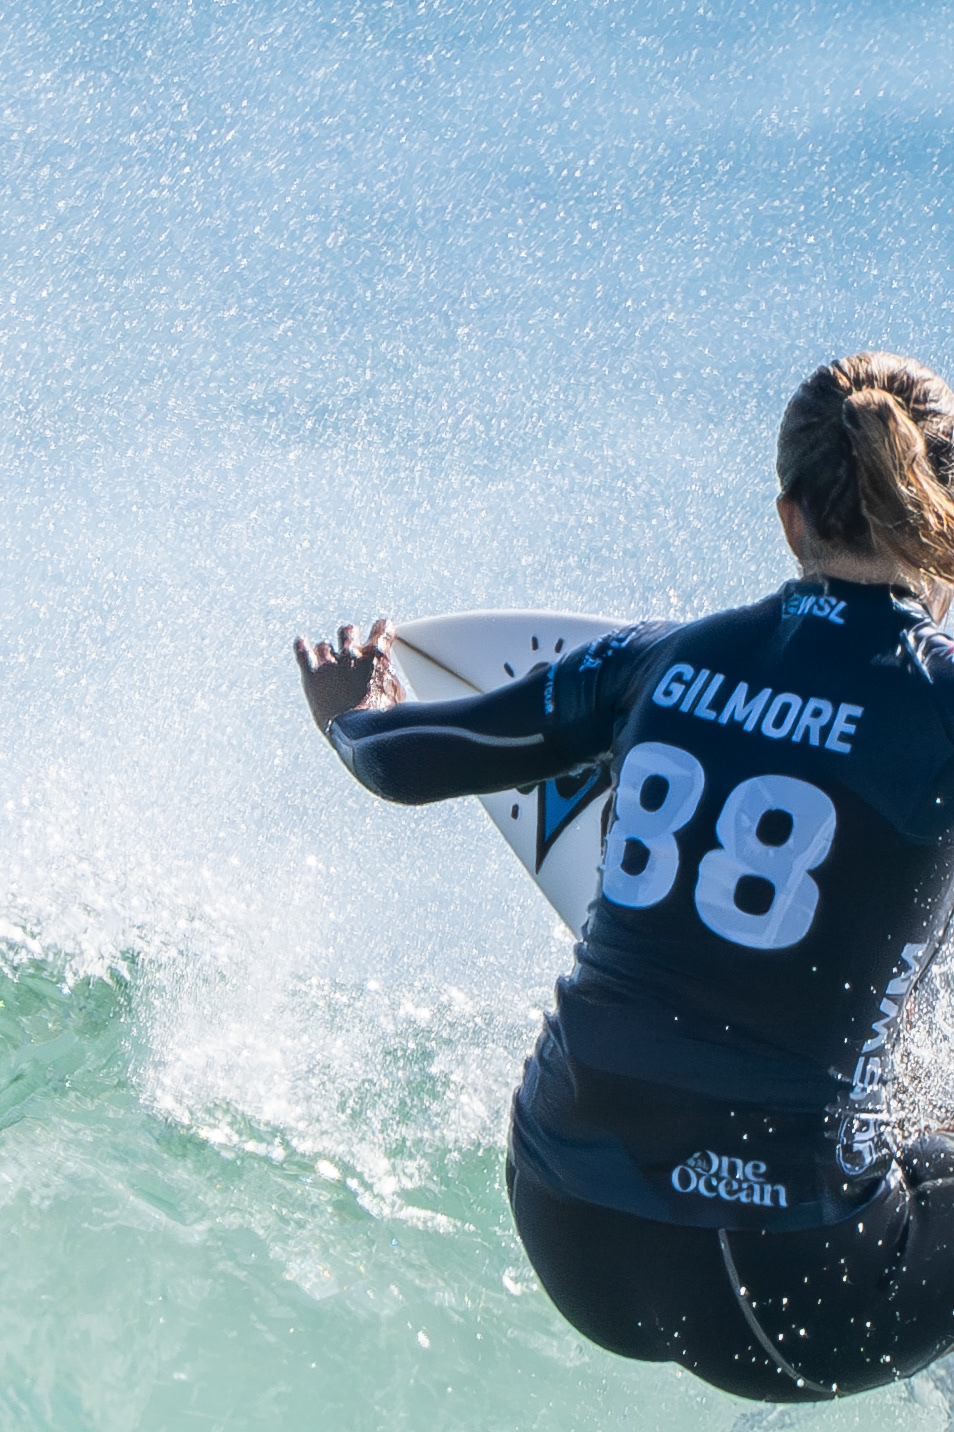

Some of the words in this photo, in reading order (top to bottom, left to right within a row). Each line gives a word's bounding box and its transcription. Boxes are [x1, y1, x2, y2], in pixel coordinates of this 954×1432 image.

[652, 662, 864, 753] GILMORE
[602, 742, 837, 950] 88
[671, 1165, 788, 1207] Ocean
[686, 1150, 767, 1182] One
